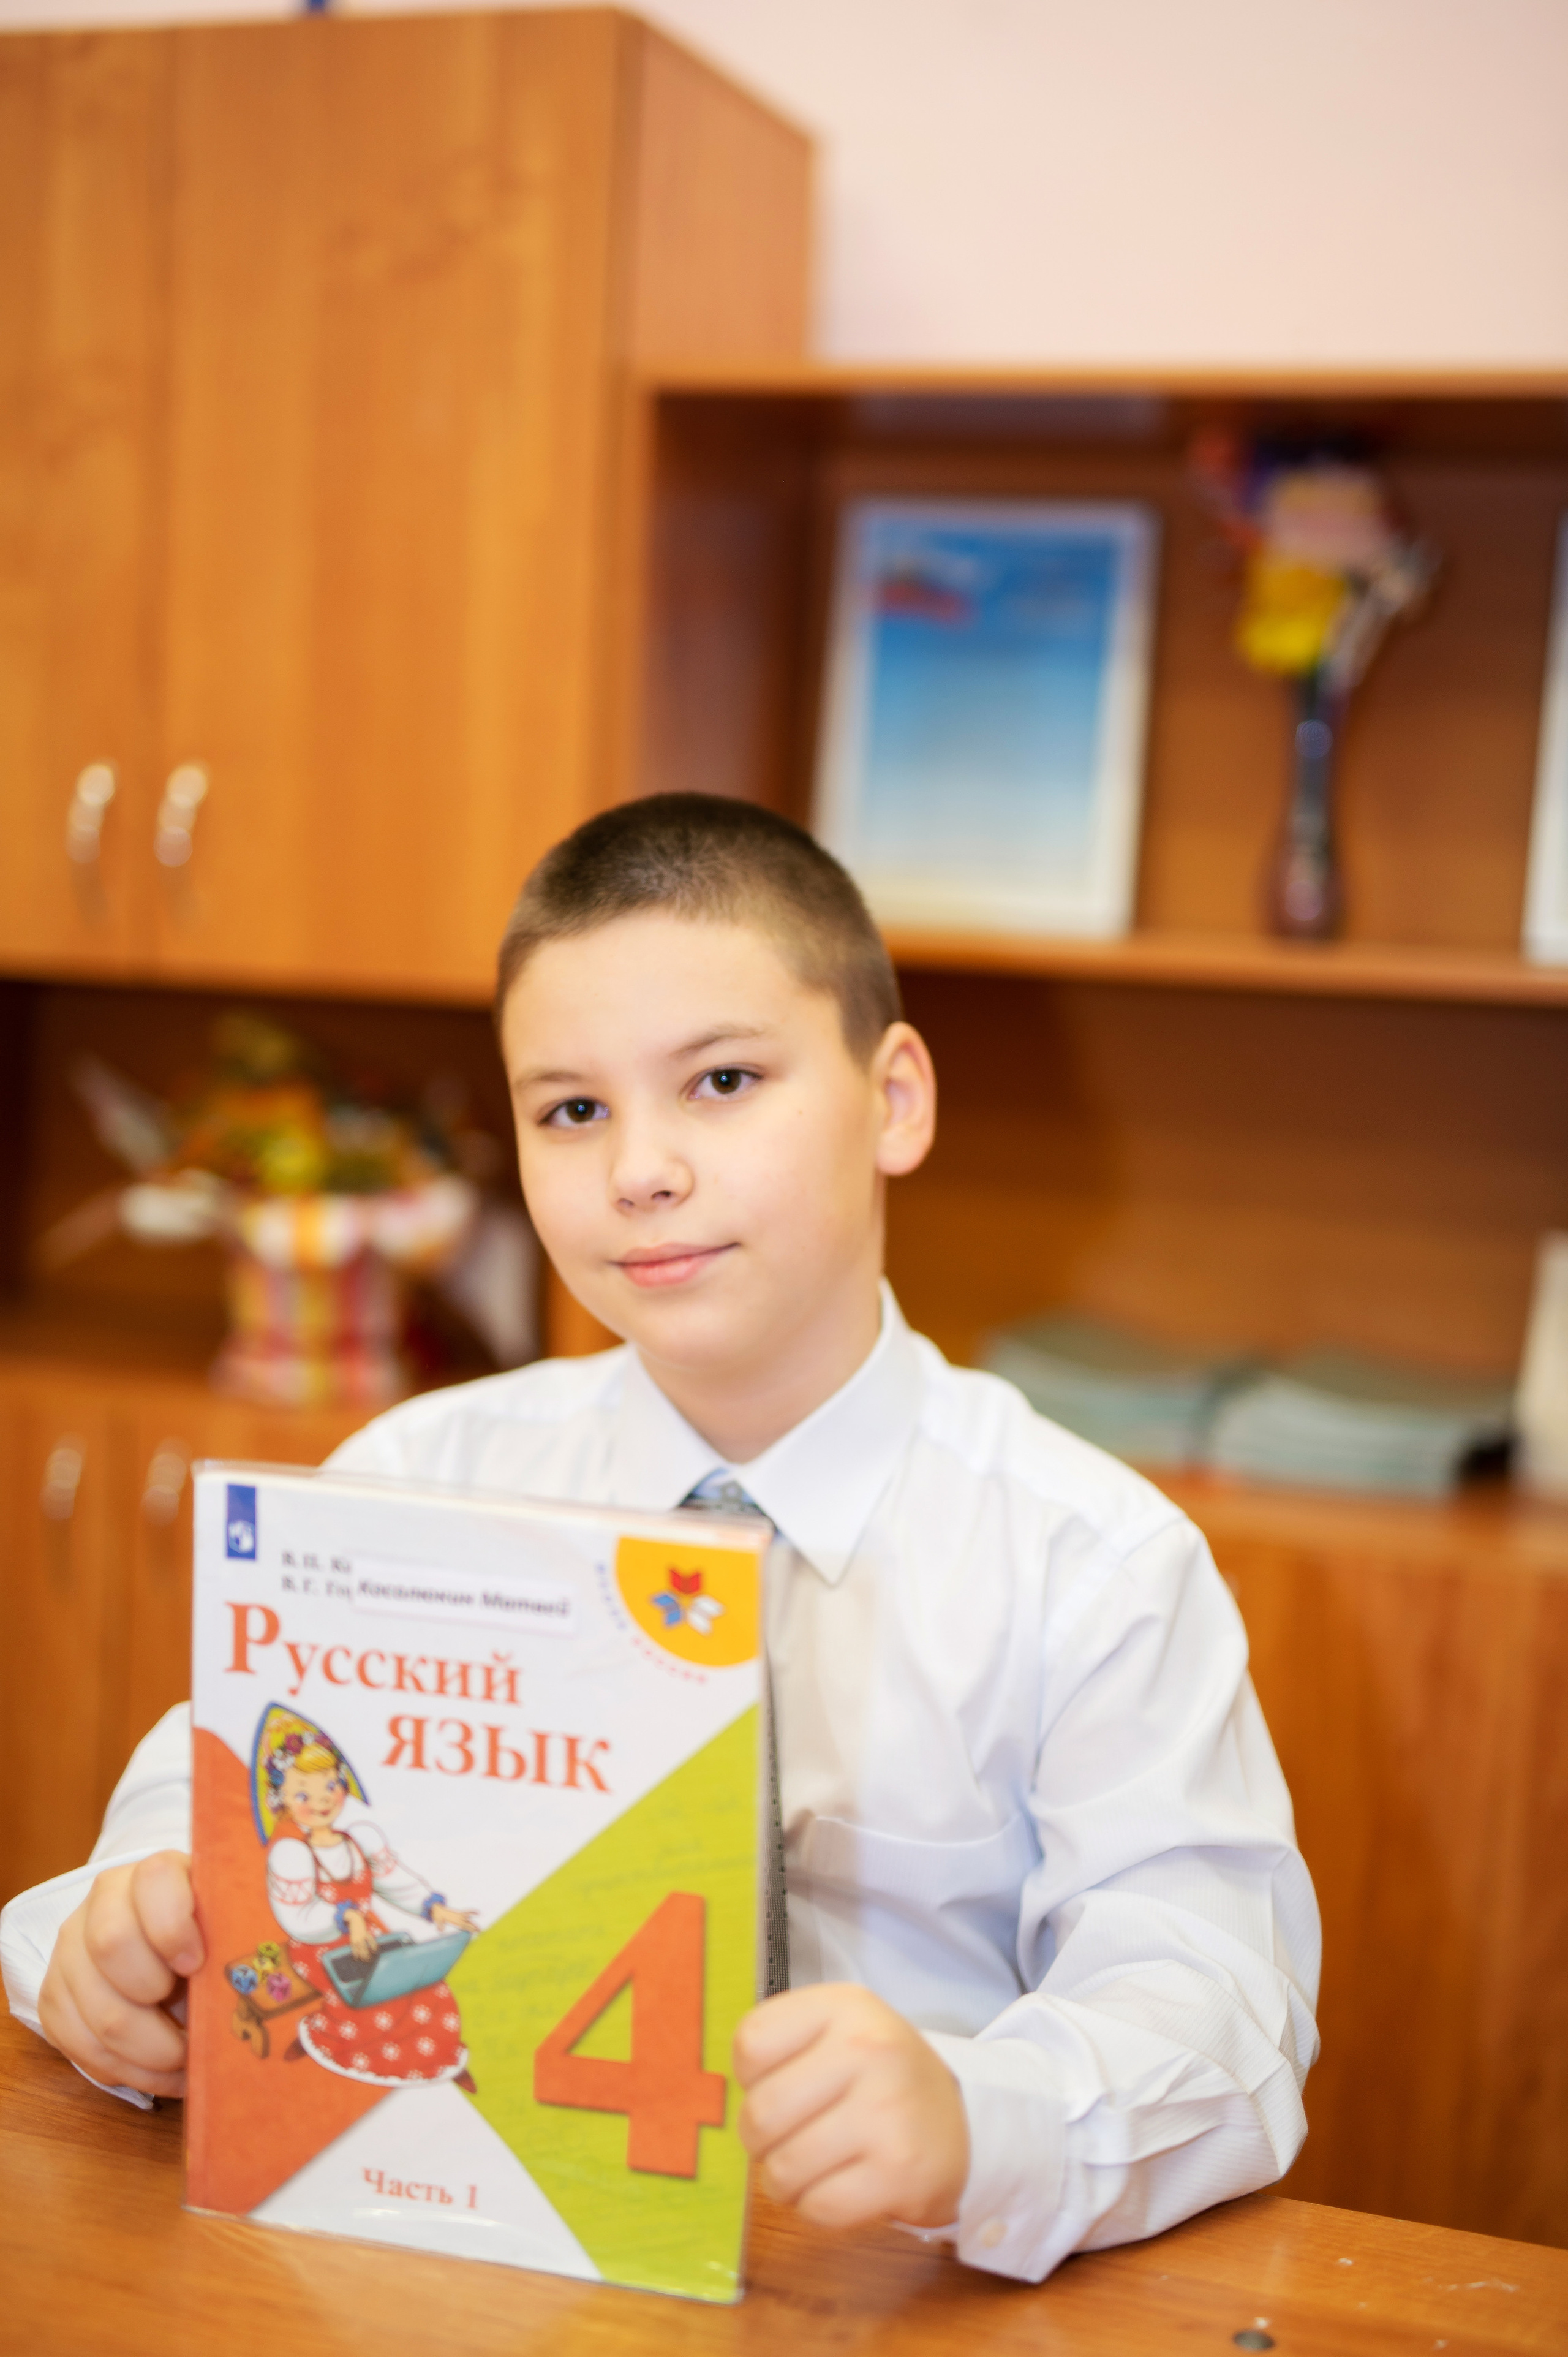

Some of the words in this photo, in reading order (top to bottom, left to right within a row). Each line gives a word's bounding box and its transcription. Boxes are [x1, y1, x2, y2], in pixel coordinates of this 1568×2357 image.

[224, 1600, 524, 1706] Русский
[534, 1891, 726, 2179] 4
[361, 2166, 453, 2206] Часть
[466, 2183, 478, 2209] 1
